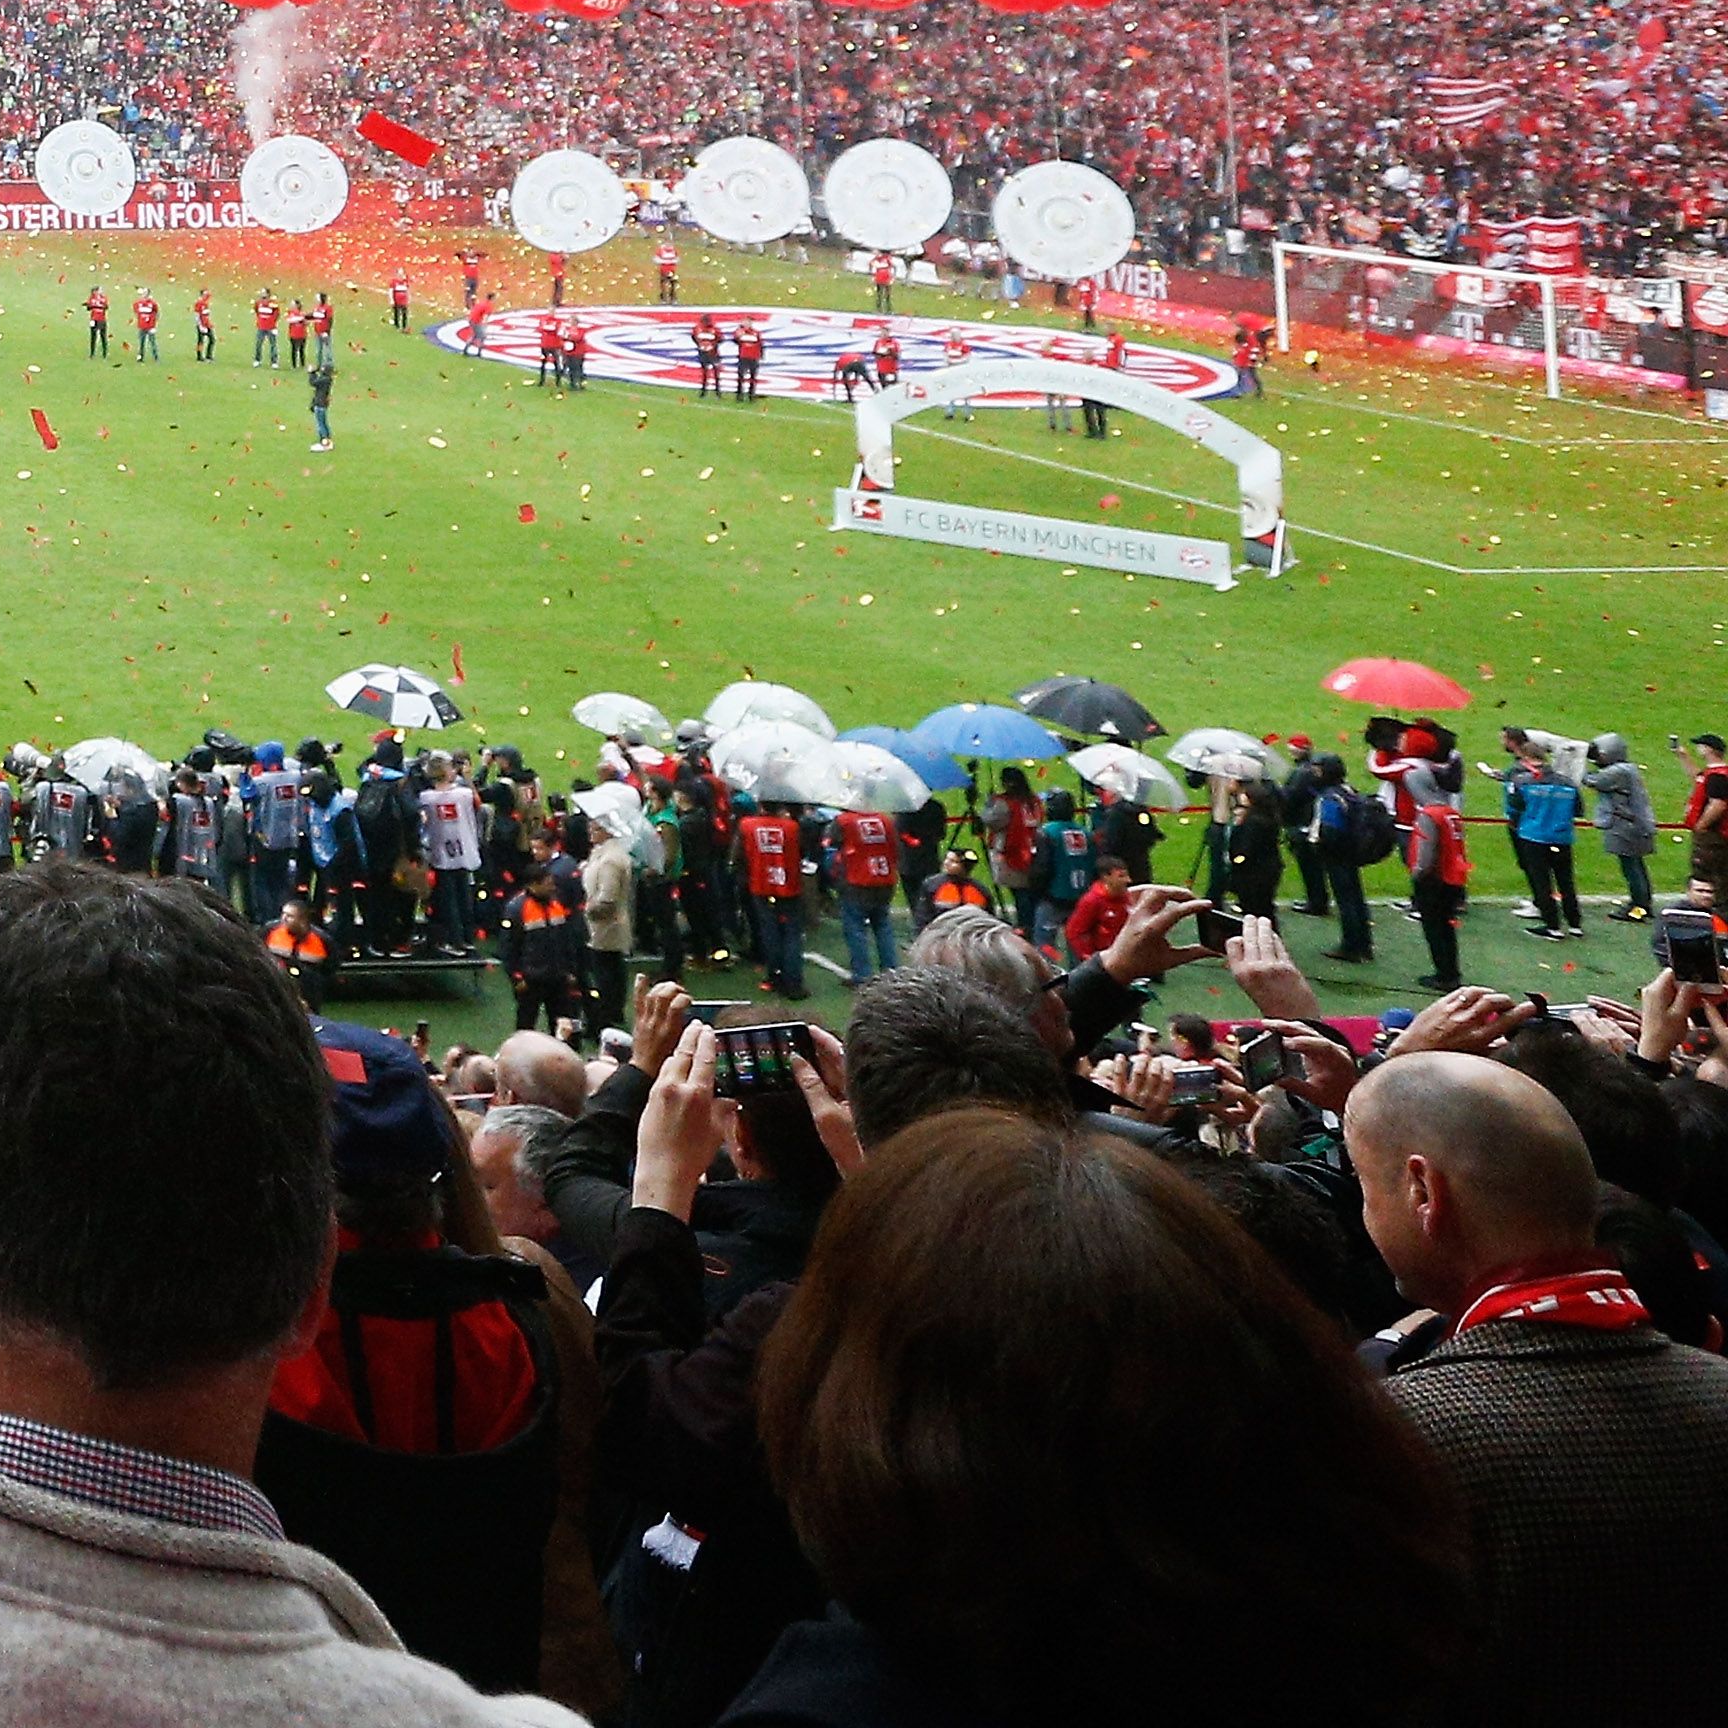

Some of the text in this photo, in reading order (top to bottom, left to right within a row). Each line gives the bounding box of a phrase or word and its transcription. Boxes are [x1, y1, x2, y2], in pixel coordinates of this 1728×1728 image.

[137, 203, 165, 229] IN
[170, 202, 259, 229] FOLGE
[1110, 261, 1169, 300] VIER
[904, 508, 930, 530] FC
[937, 513, 1026, 544] BAYERN
